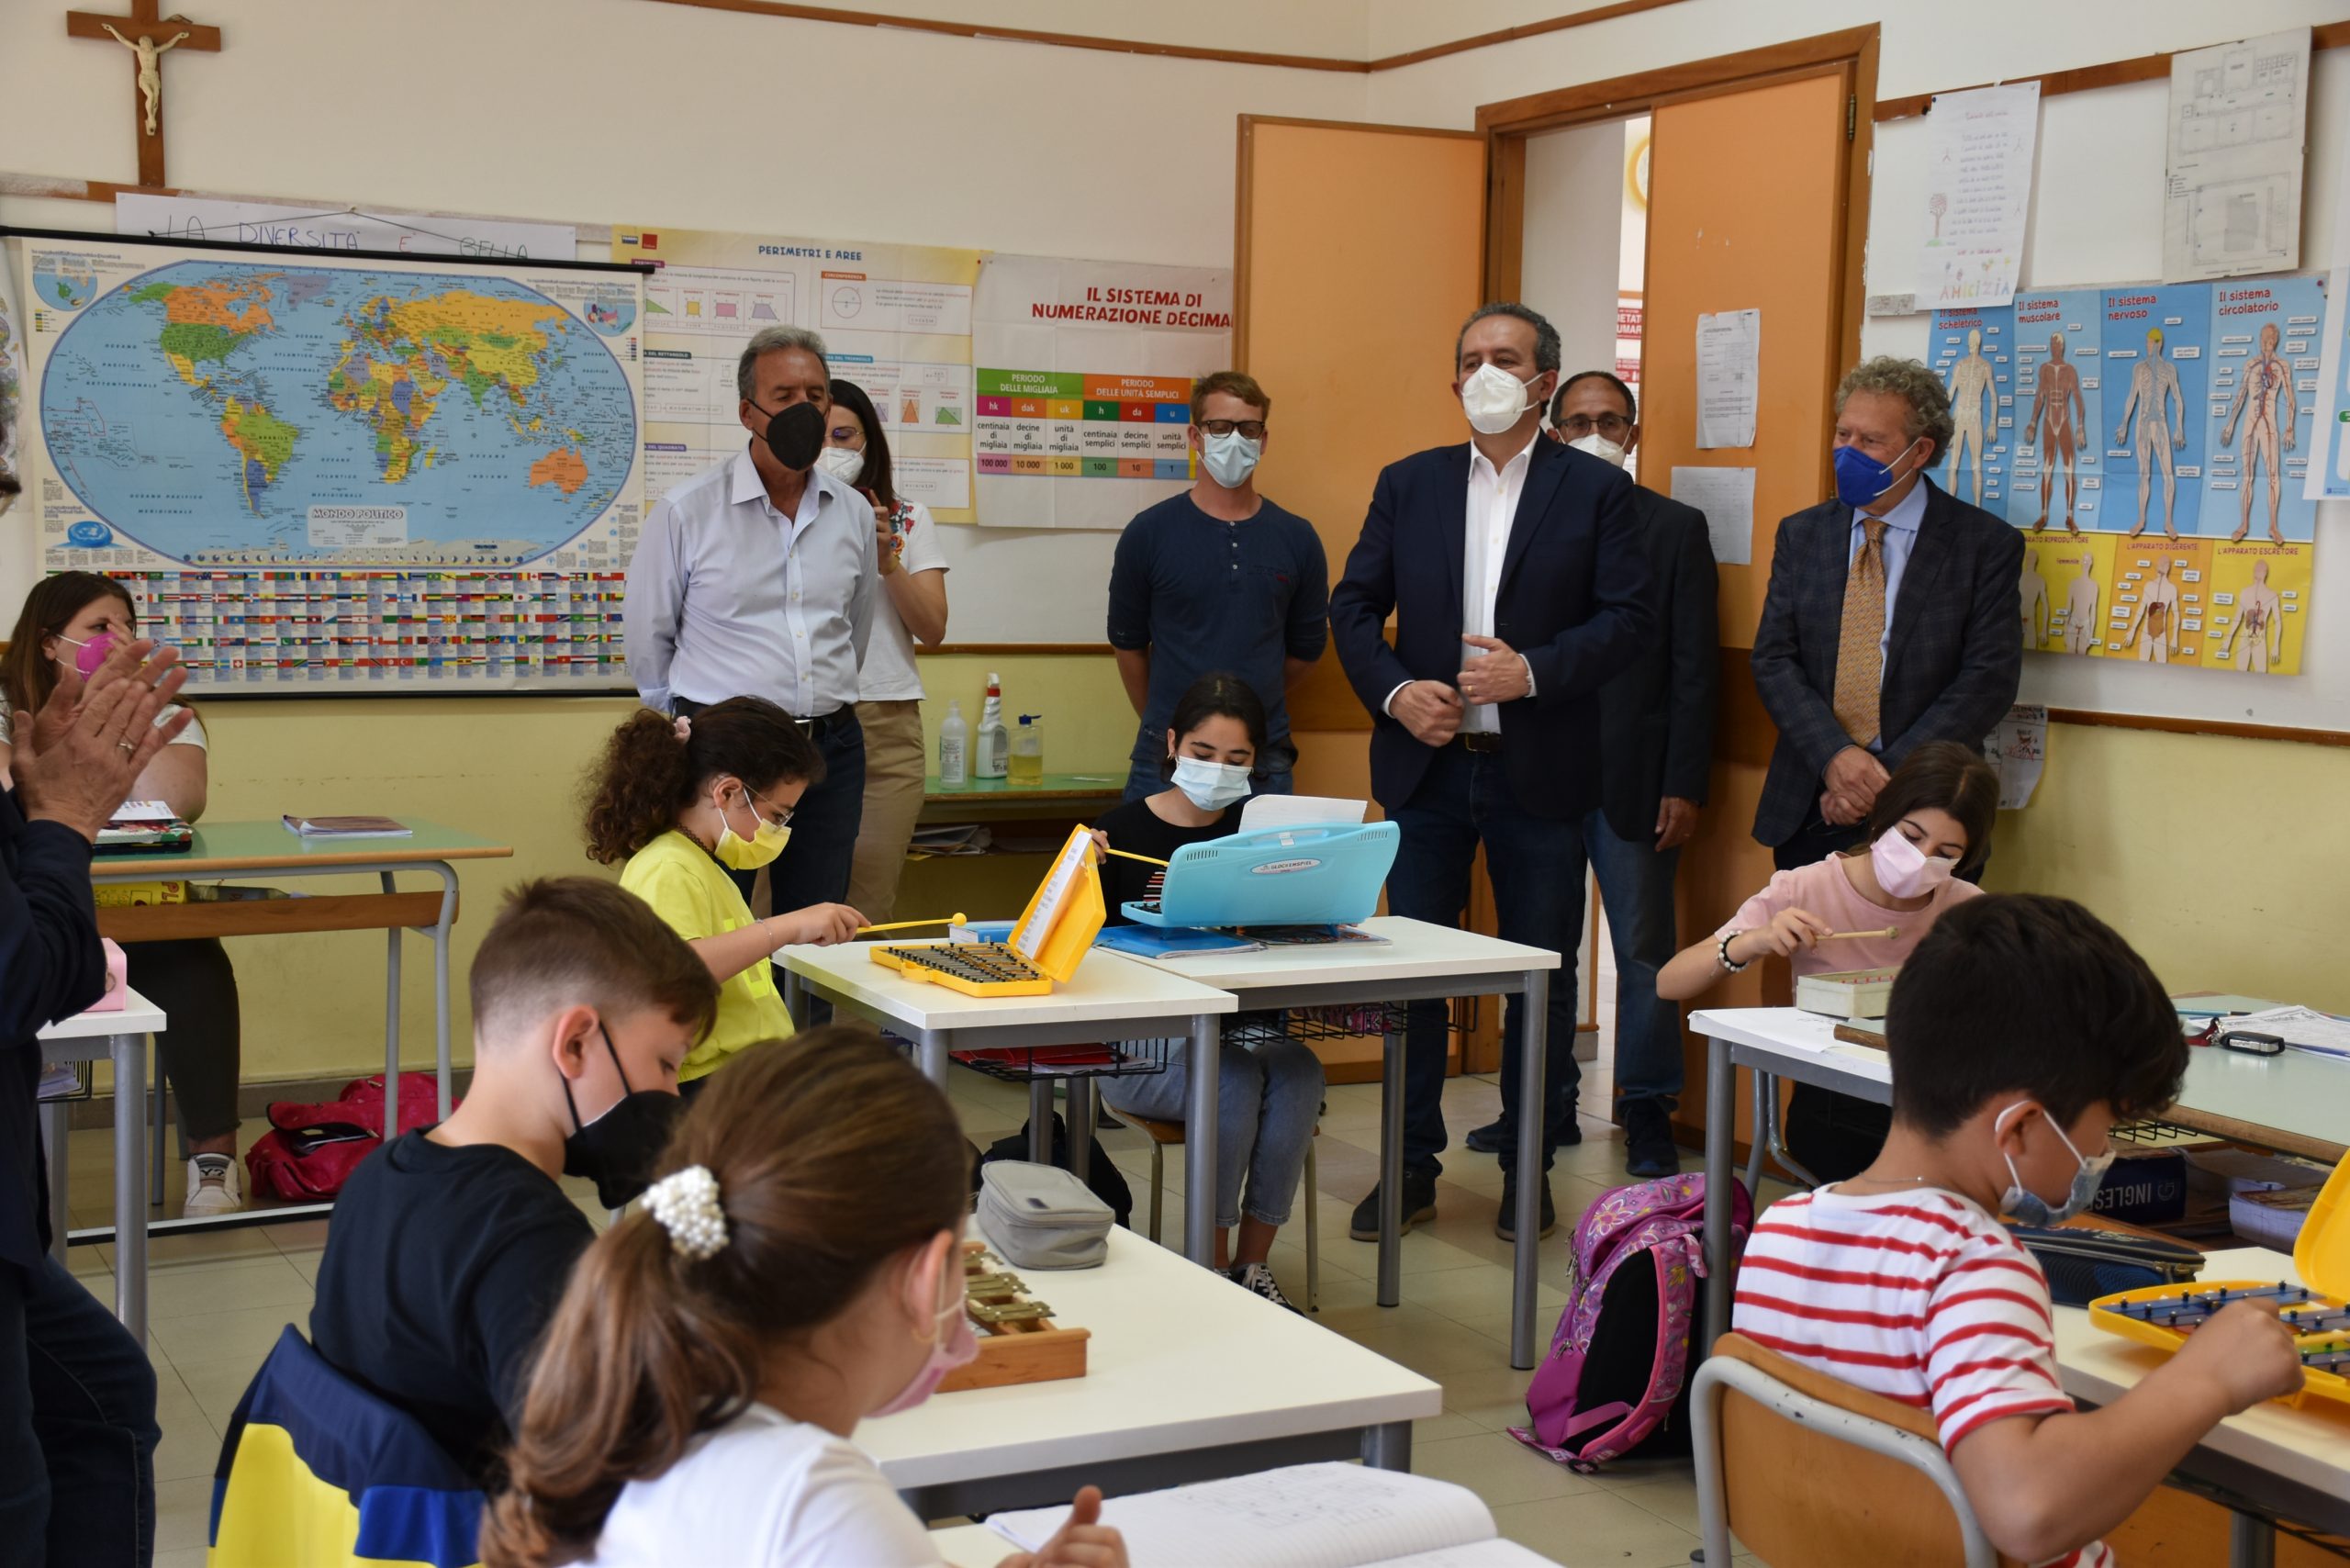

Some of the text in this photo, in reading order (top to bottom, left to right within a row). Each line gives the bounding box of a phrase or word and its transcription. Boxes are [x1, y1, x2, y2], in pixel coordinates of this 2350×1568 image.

[758, 245, 862, 262] PERIMETRI E AREE
[1087, 287, 1202, 308] IL SISTEMA DI
[2219, 288, 2271, 302] Il sistema
[2019, 299, 2059, 311] Il sistema
[2108, 295, 2157, 308] Il sistema
[2219, 301, 2278, 316] circolatorio
[1032, 304, 1233, 328] NUMERAZIONE DECIMA
[2019, 311, 2061, 324] muscolare
[2108, 309, 2148, 321] nervoso
[1617, 324, 1641, 334] UMAR
[1938, 319, 1983, 330] scheletrico
[1012, 374, 1046, 384] PERIODO
[1121, 378, 1154, 388] PERIODO
[1000, 384, 1058, 394] DELLE MIGLIAIA
[1096, 387, 1180, 399] DELLE UNITÀ SEMPLICI
[989, 401, 999, 410] hk
[1021, 403, 1035, 413] dak
[1059, 405, 1070, 414] uk
[1099, 406, 1104, 415] h
[1132, 408, 1142, 417] da
[977, 421, 1010, 431] centinaia
[1016, 422, 1040, 432] decine
[1054, 424, 1074, 433] unità
[990, 431, 998, 440] di
[1024, 432, 1032, 441] di
[1060, 434, 1068, 442] di
[1083, 430, 1117, 439] centinaia
[1124, 431, 1148, 441] decine
[1162, 432, 1181, 441] unità
[979, 440, 1008, 450] migliaia
[1013, 442, 1043, 451] migliaia
[1049, 442, 1079, 453] migliaia
[1085, 439, 1115, 449] semplici
[1121, 440, 1151, 450] semplici
[1157, 442, 1187, 451] semplici
[980, 459, 1007, 468] 100 000
[1016, 461, 1040, 469] 10 000
[1060, 462, 1074, 470] 000
[1093, 463, 1107, 471] 100
[1132, 464, 1141, 472] 10
[312, 508, 404, 521] MONDO POLITICO
[2044, 536, 2089, 544] RIPRODUTTORE
[2165, 543, 2199, 551] DIGERENTE
[2218, 547, 2258, 555] L'APPARATO
[2086, 1183, 2152, 1211] INGLES
